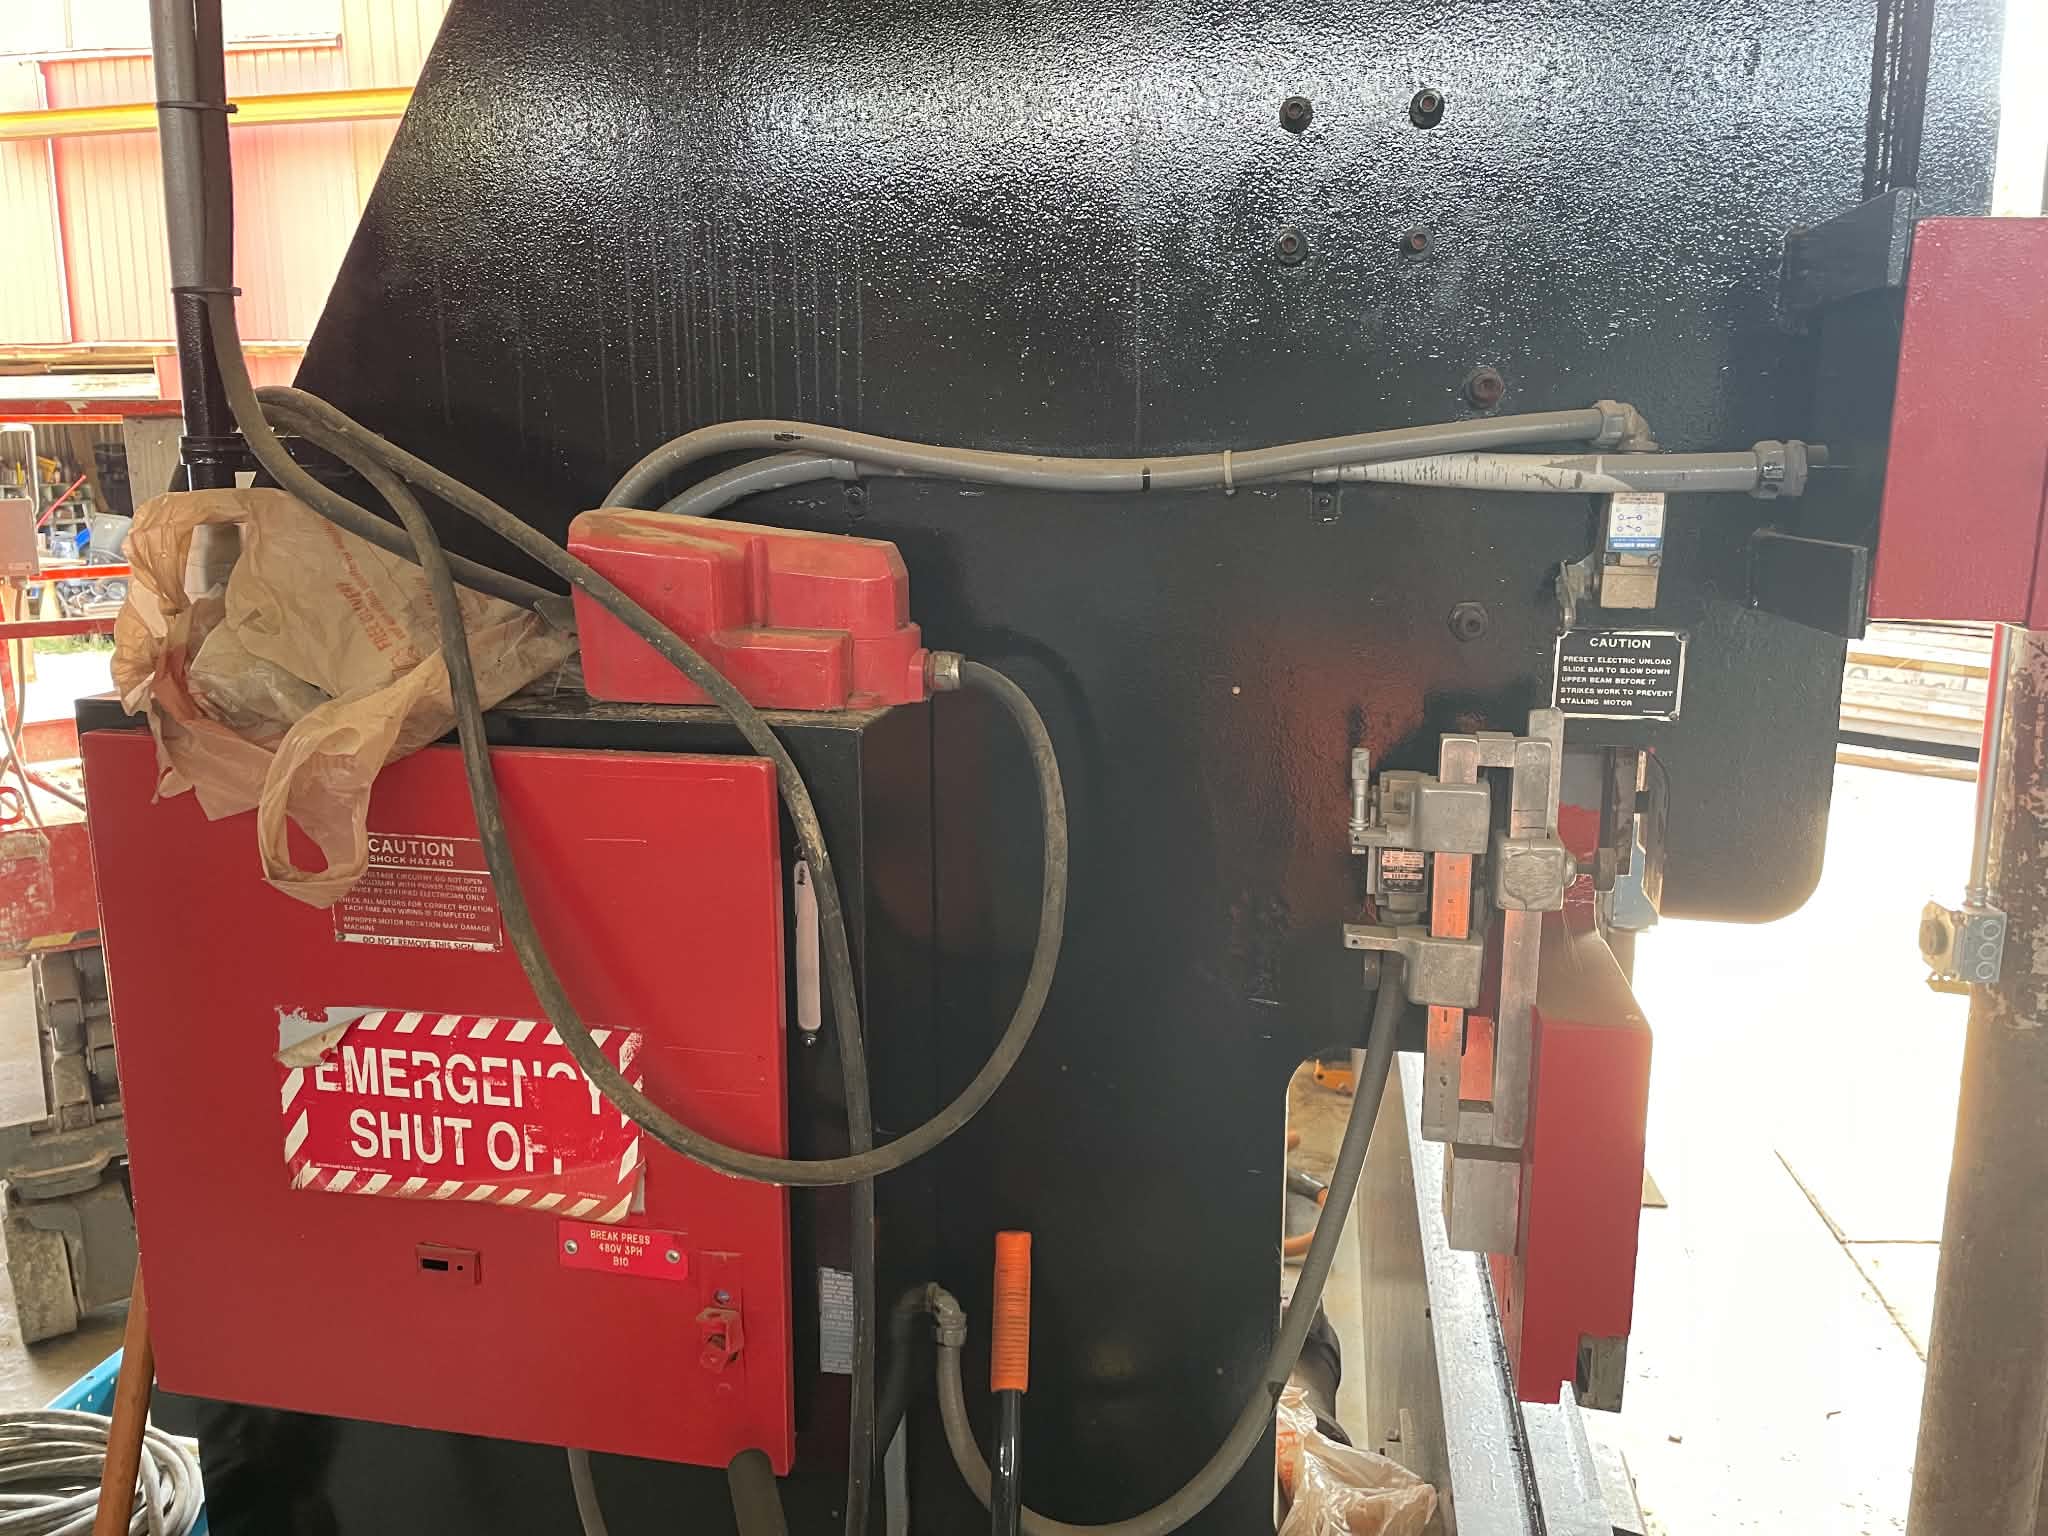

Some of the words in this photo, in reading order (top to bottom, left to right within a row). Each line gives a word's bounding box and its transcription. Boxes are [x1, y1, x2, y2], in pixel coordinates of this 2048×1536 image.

[1589, 637, 1652, 649] CAUTION
[1563, 655, 1595, 663] PRESET
[1597, 656, 1636, 665] ELECTRIC
[1562, 665, 1586, 673] SLIDE
[1560, 697, 1599, 705] STALLING
[368, 838, 455, 857] CAUTION
[369, 855, 406, 864] SHOCK
[409, 857, 455, 867] HAZARD
[445, 884, 488, 893] CONNECTED
[424, 902, 457, 910] CORRECT
[458, 904, 494, 912] ROTATION
[433, 910, 476, 919] COMPLETED
[343, 923, 375, 932] MACHINE
[405, 920, 440, 928] ROTATION
[460, 923, 491, 932] DAMAGE
[362, 936, 376, 944] DO
[377, 937, 394, 945] NOT
[398, 938, 433, 949] REMOVE
[435, 940, 451, 950] THIS
[454, 941, 475, 951] SIGN
[350, 1108, 472, 1166] SHUT
[486, 1121, 563, 1176] OF
[590, 1229, 619, 1241] BREAK
[621, 1232, 650, 1245] PRESS
[599, 1243, 622, 1254] 480V
[624, 1245, 643, 1257] 3PH
